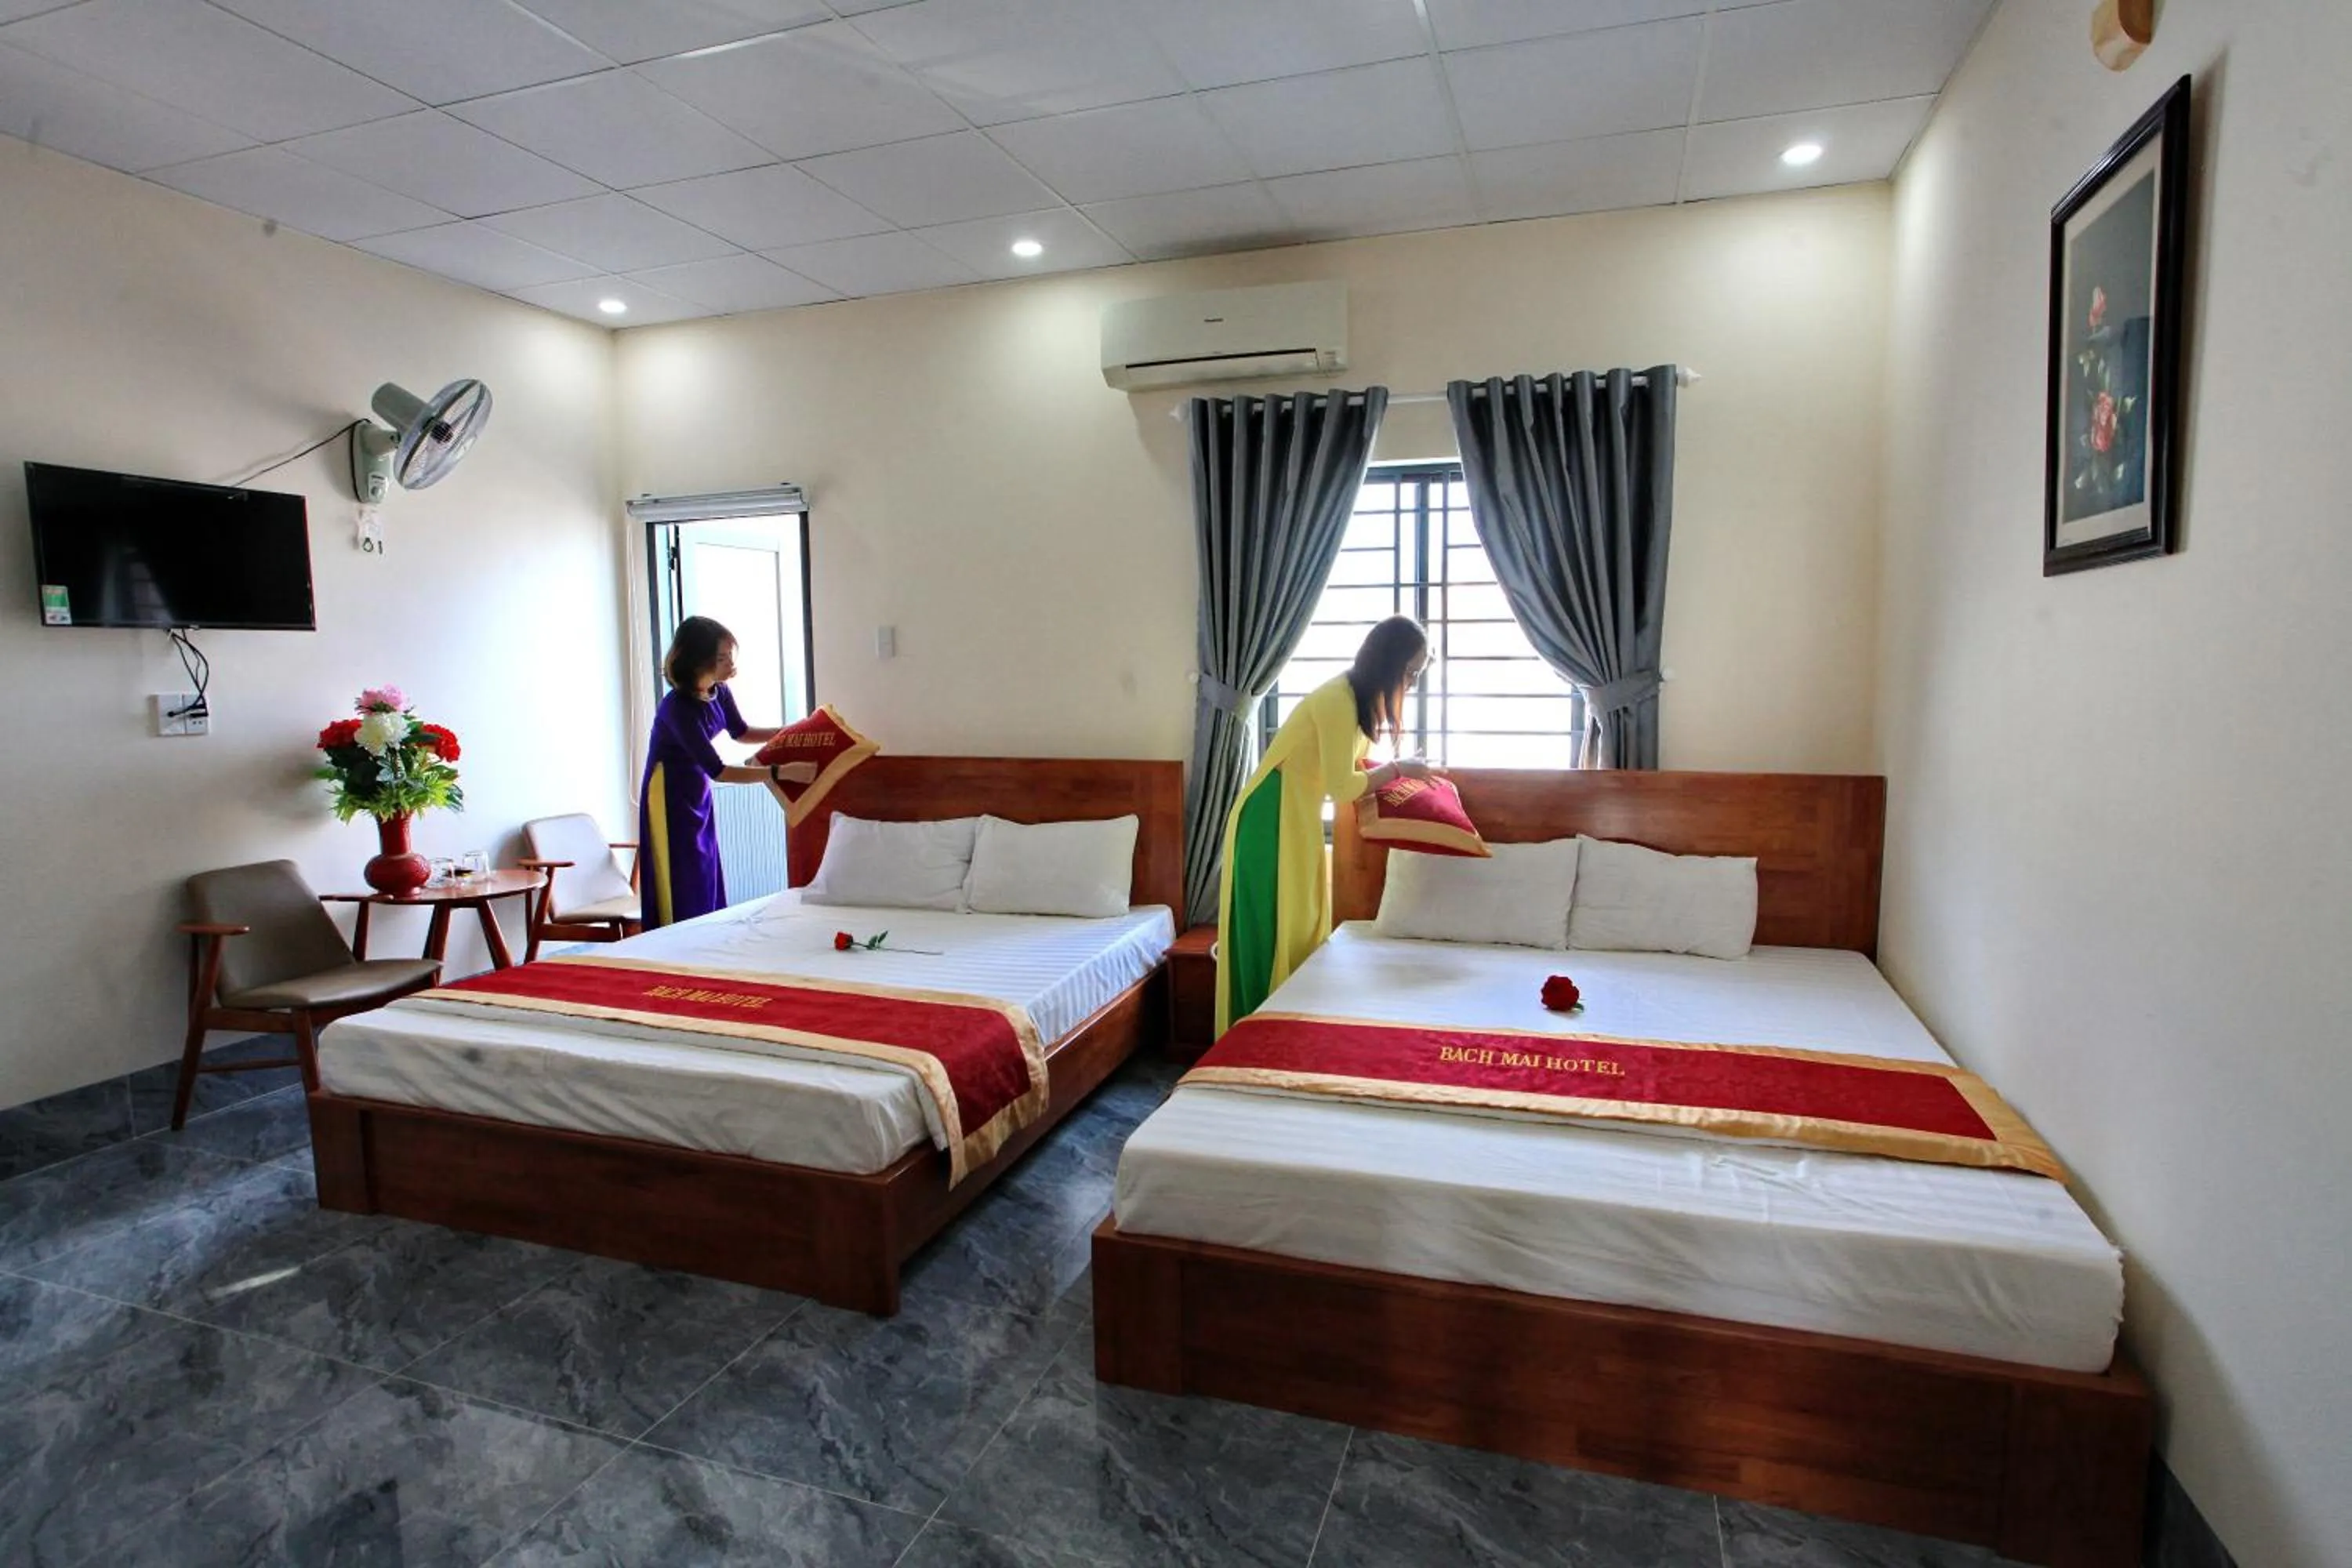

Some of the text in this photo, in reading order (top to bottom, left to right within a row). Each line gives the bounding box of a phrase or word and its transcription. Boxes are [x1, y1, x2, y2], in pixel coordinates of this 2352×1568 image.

[803, 731, 836, 747] HOTEL
[1439, 1046, 1625, 1076] BACH MAI HOTEL
